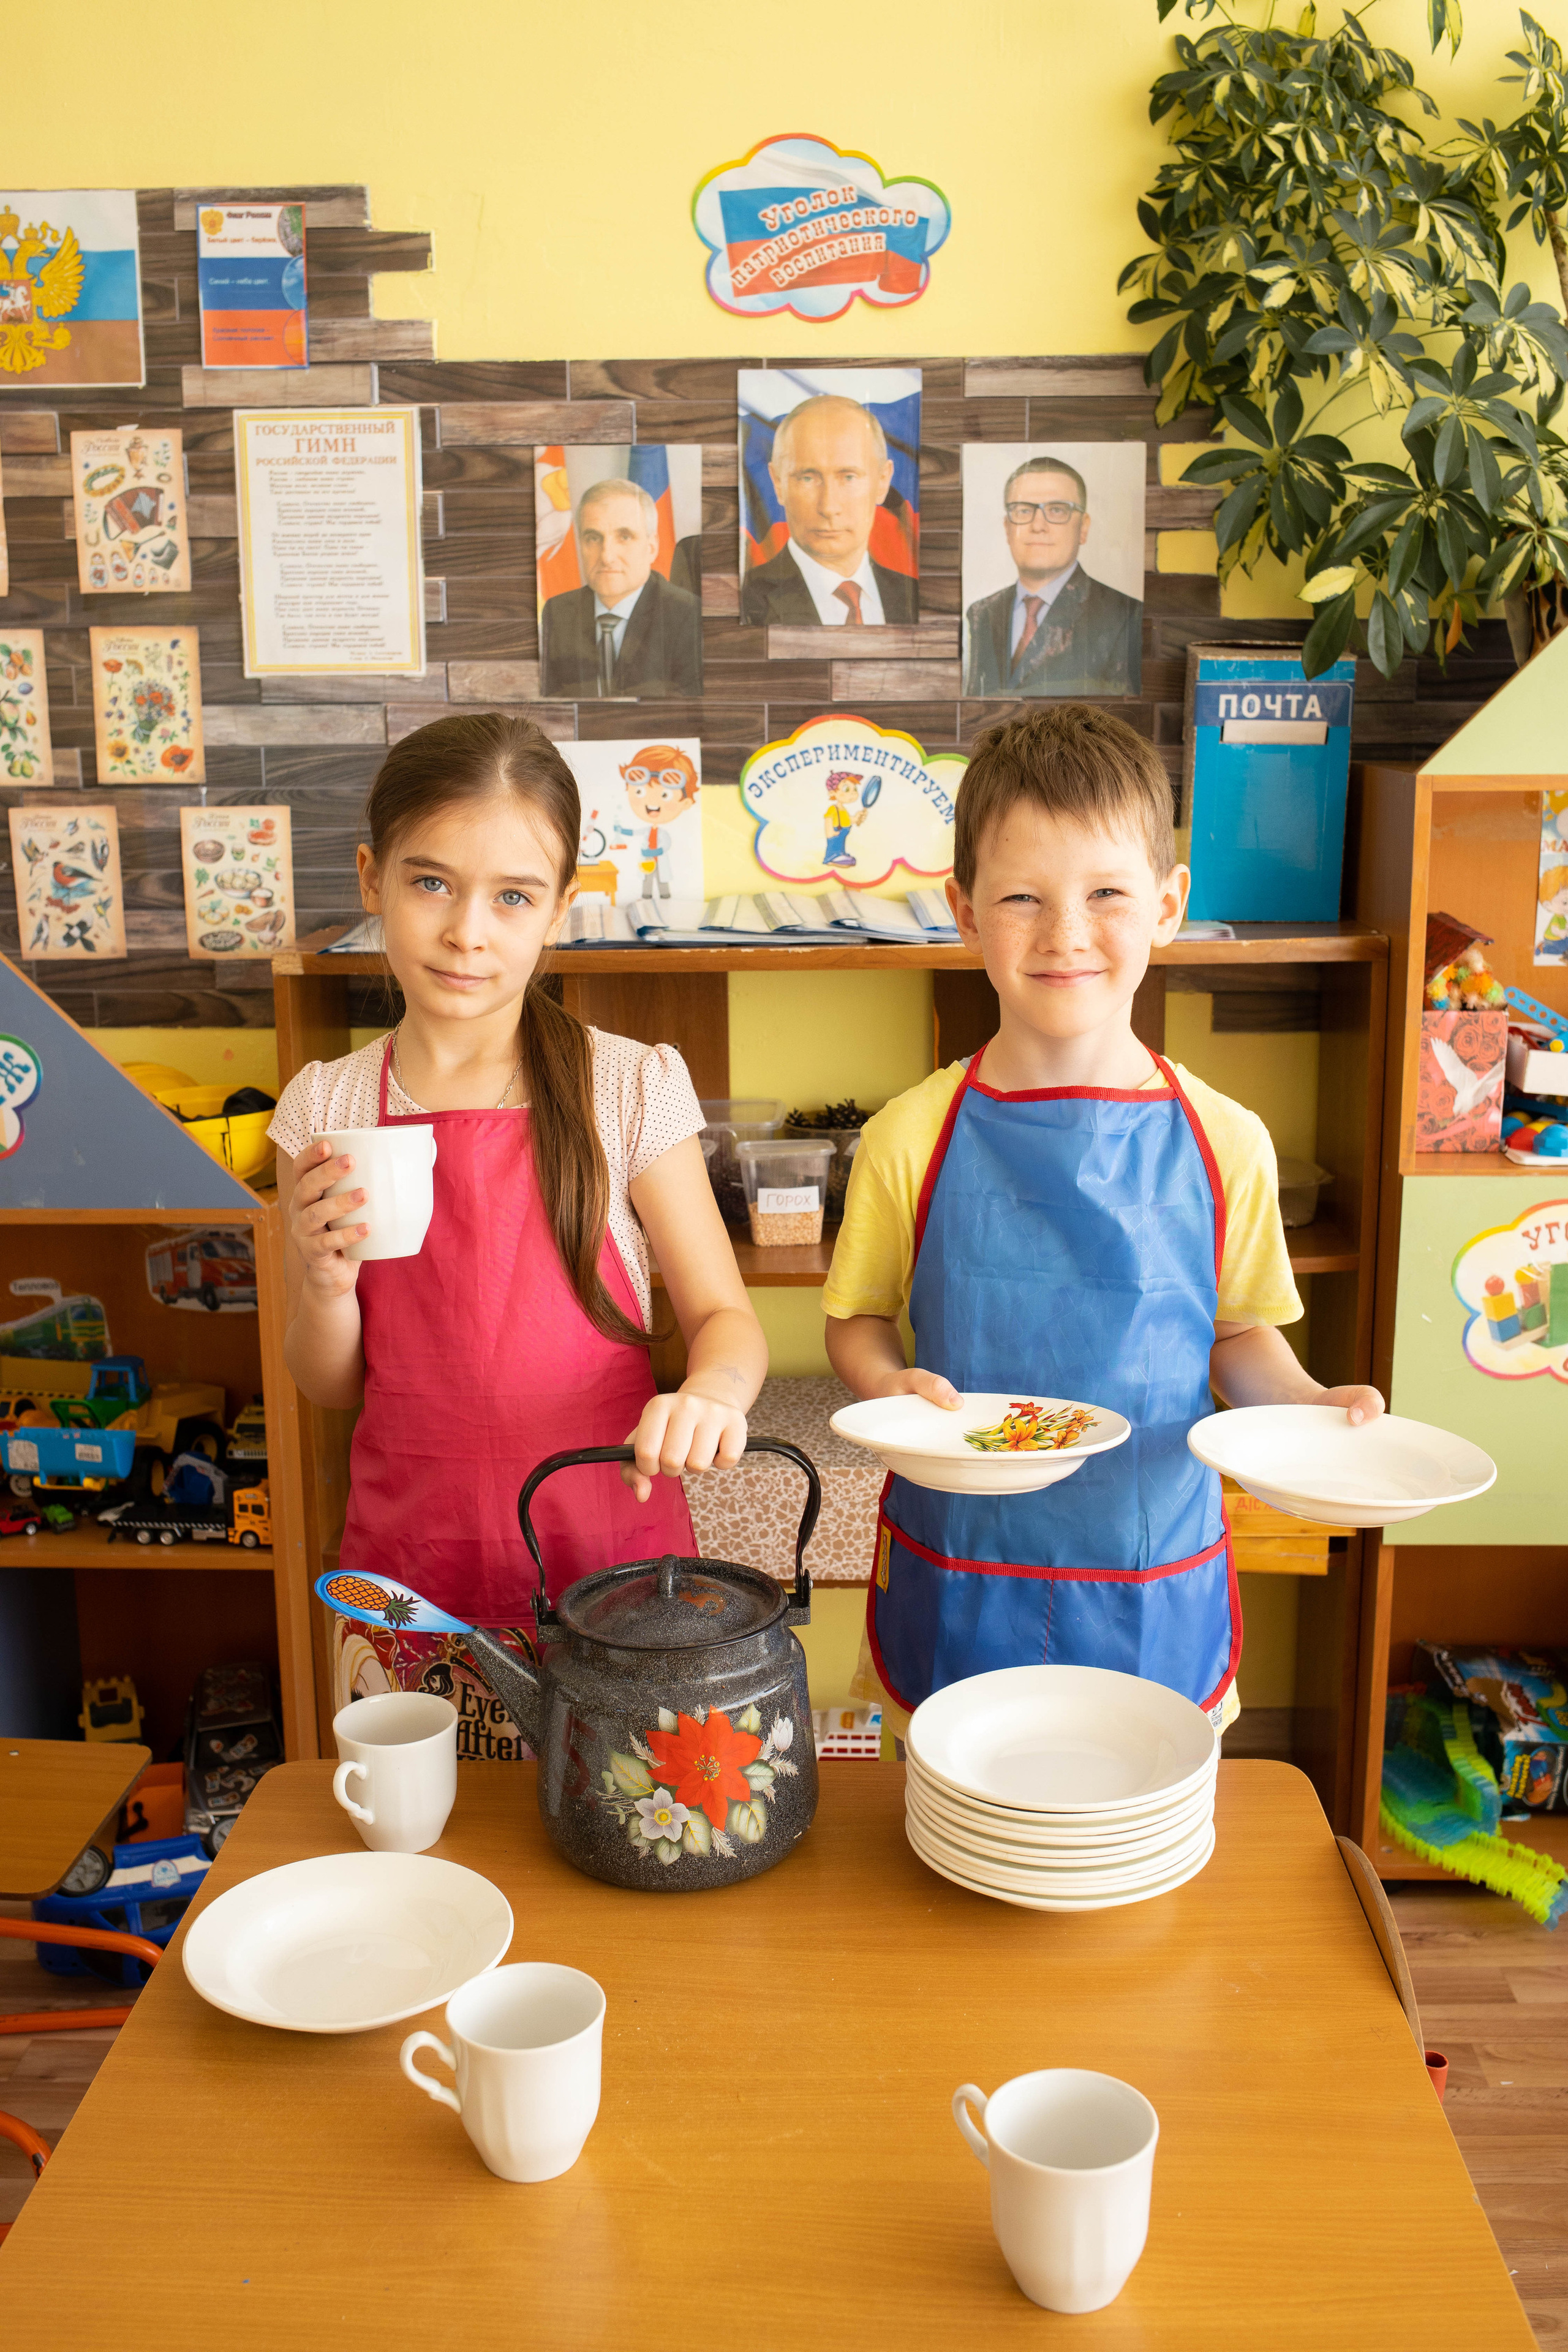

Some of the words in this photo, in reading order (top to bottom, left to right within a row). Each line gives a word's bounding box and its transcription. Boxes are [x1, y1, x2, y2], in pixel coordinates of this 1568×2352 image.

[760, 185, 856, 230] Уголок
[732, 208, 917, 286] патриотического
[771, 233, 884, 285] воспитания
[255, 421, 396, 436] ГОСУДАРСТВЕННЫЙ
[295, 437, 356, 453] ГИМН
[255, 456, 328, 467] РОССИЙСКОЙ
[331, 456, 398, 466] ФЕДЕРАЦИИ
[1218, 693, 1323, 719] ПОЧТА
[747, 744, 955, 825] ЭКСПЕРИМЕНТИРУЕМ
[1522, 1221, 1568, 1251] УГ
[458, 1681, 514, 1724] Eve
